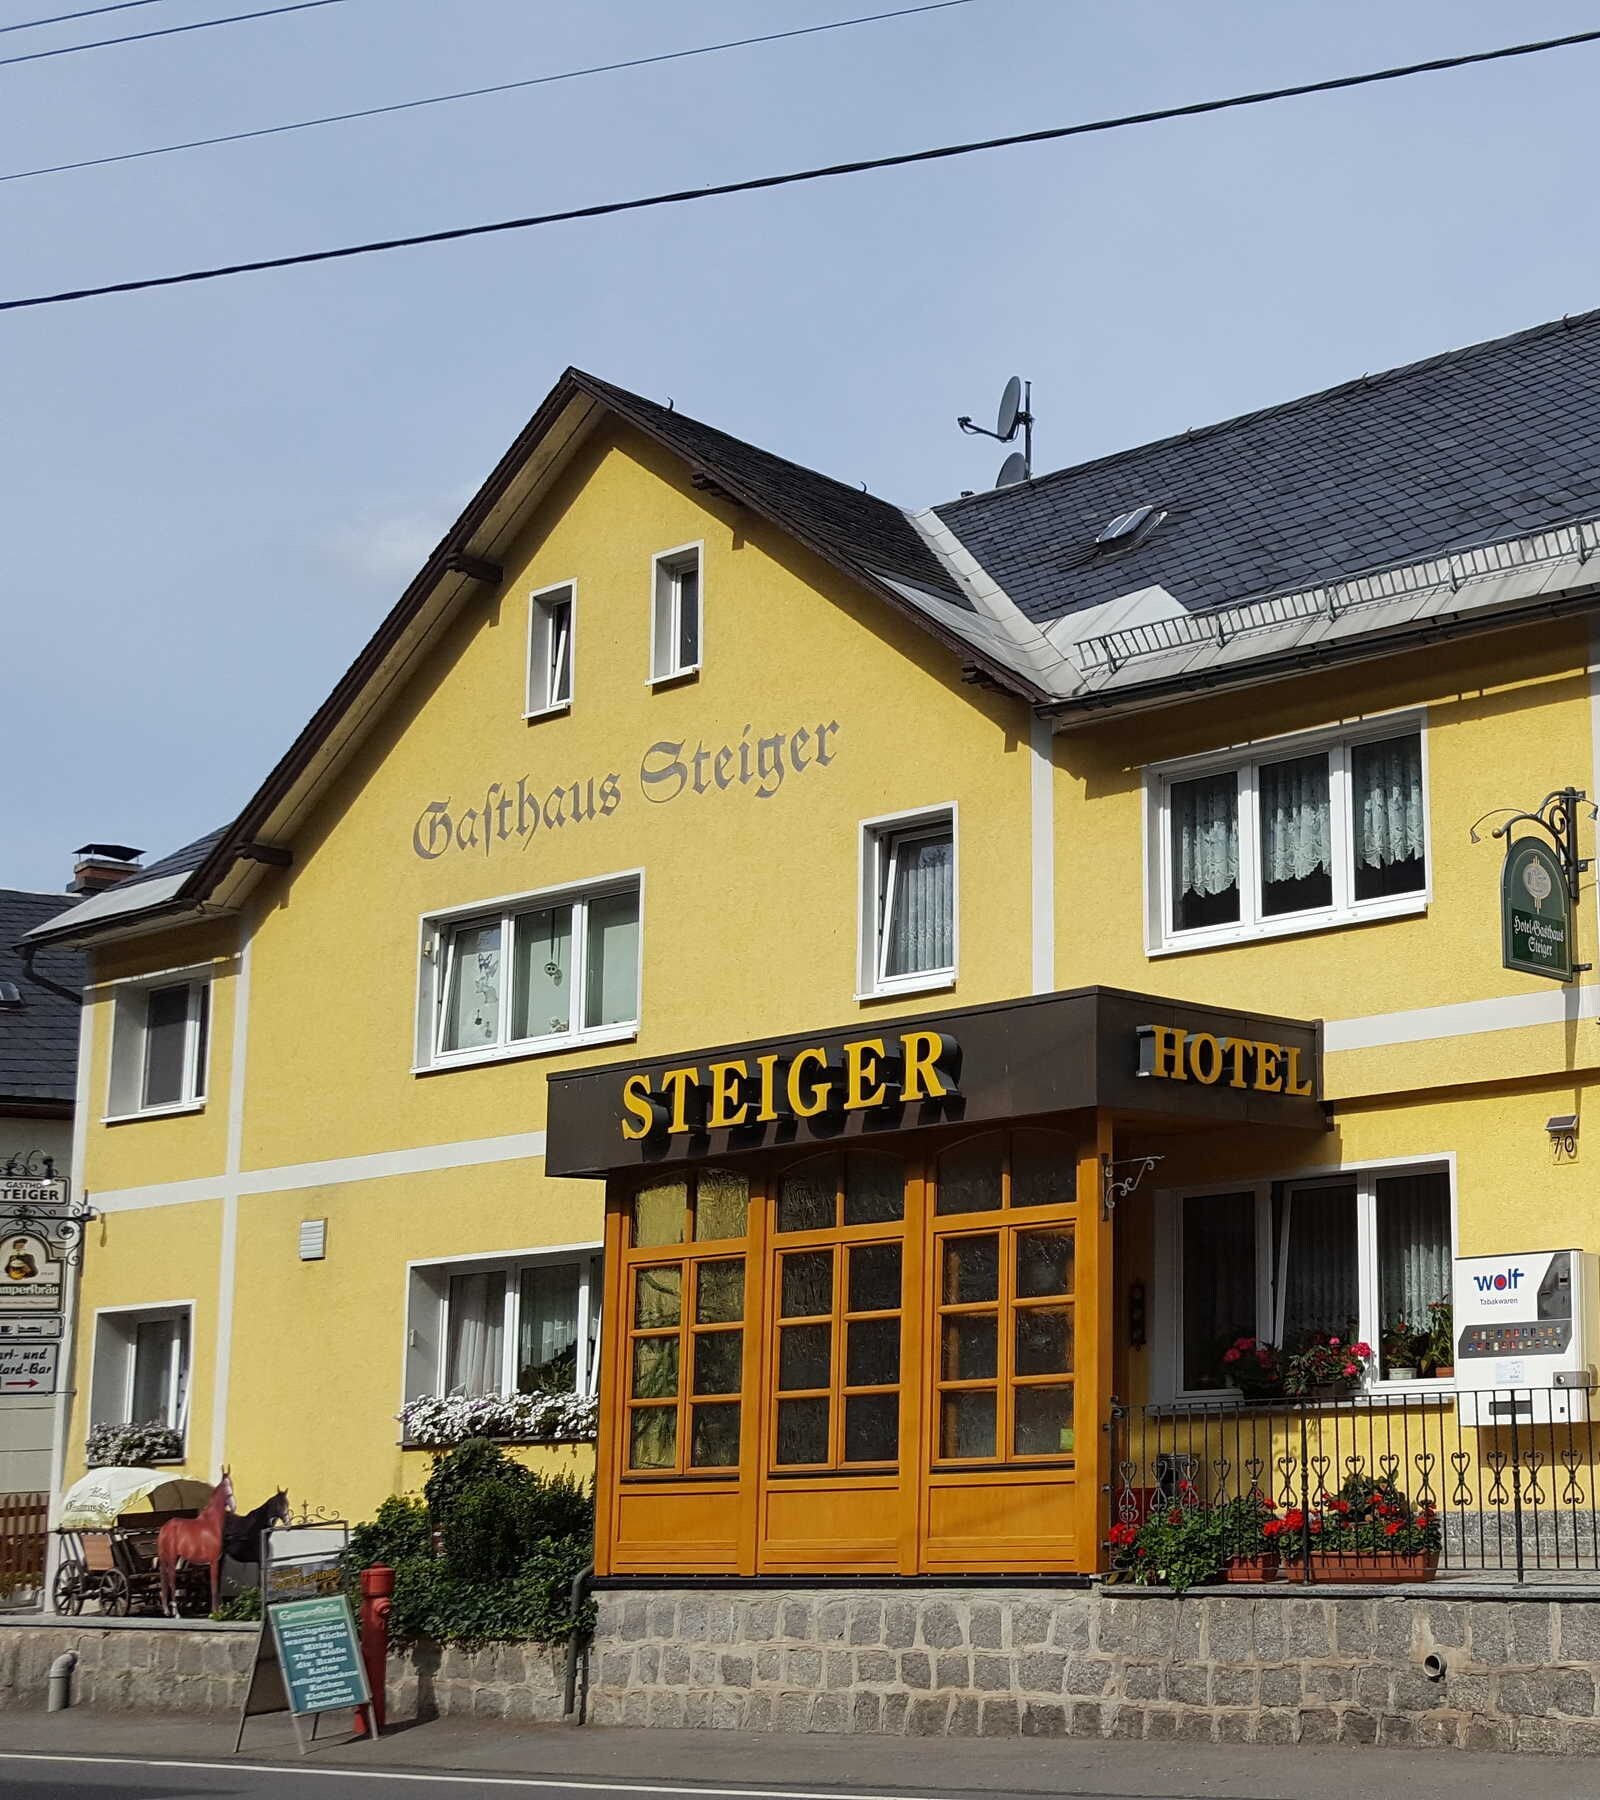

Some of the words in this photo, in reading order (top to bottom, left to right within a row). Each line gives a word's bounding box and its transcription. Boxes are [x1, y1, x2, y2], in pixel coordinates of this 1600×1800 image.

[640, 720, 840, 803] Steiger
[1149, 1024, 1313, 1096] HOTEL
[621, 1031, 947, 1139] STEIGER
[1551, 1135, 1575, 1154] 70
[6, 1181, 46, 1189] GASTHO
[1472, 1268, 1525, 1292] wolf
[1480, 1297, 1518, 1306] Tabakwaren
[23, 1347, 47, 1360] und
